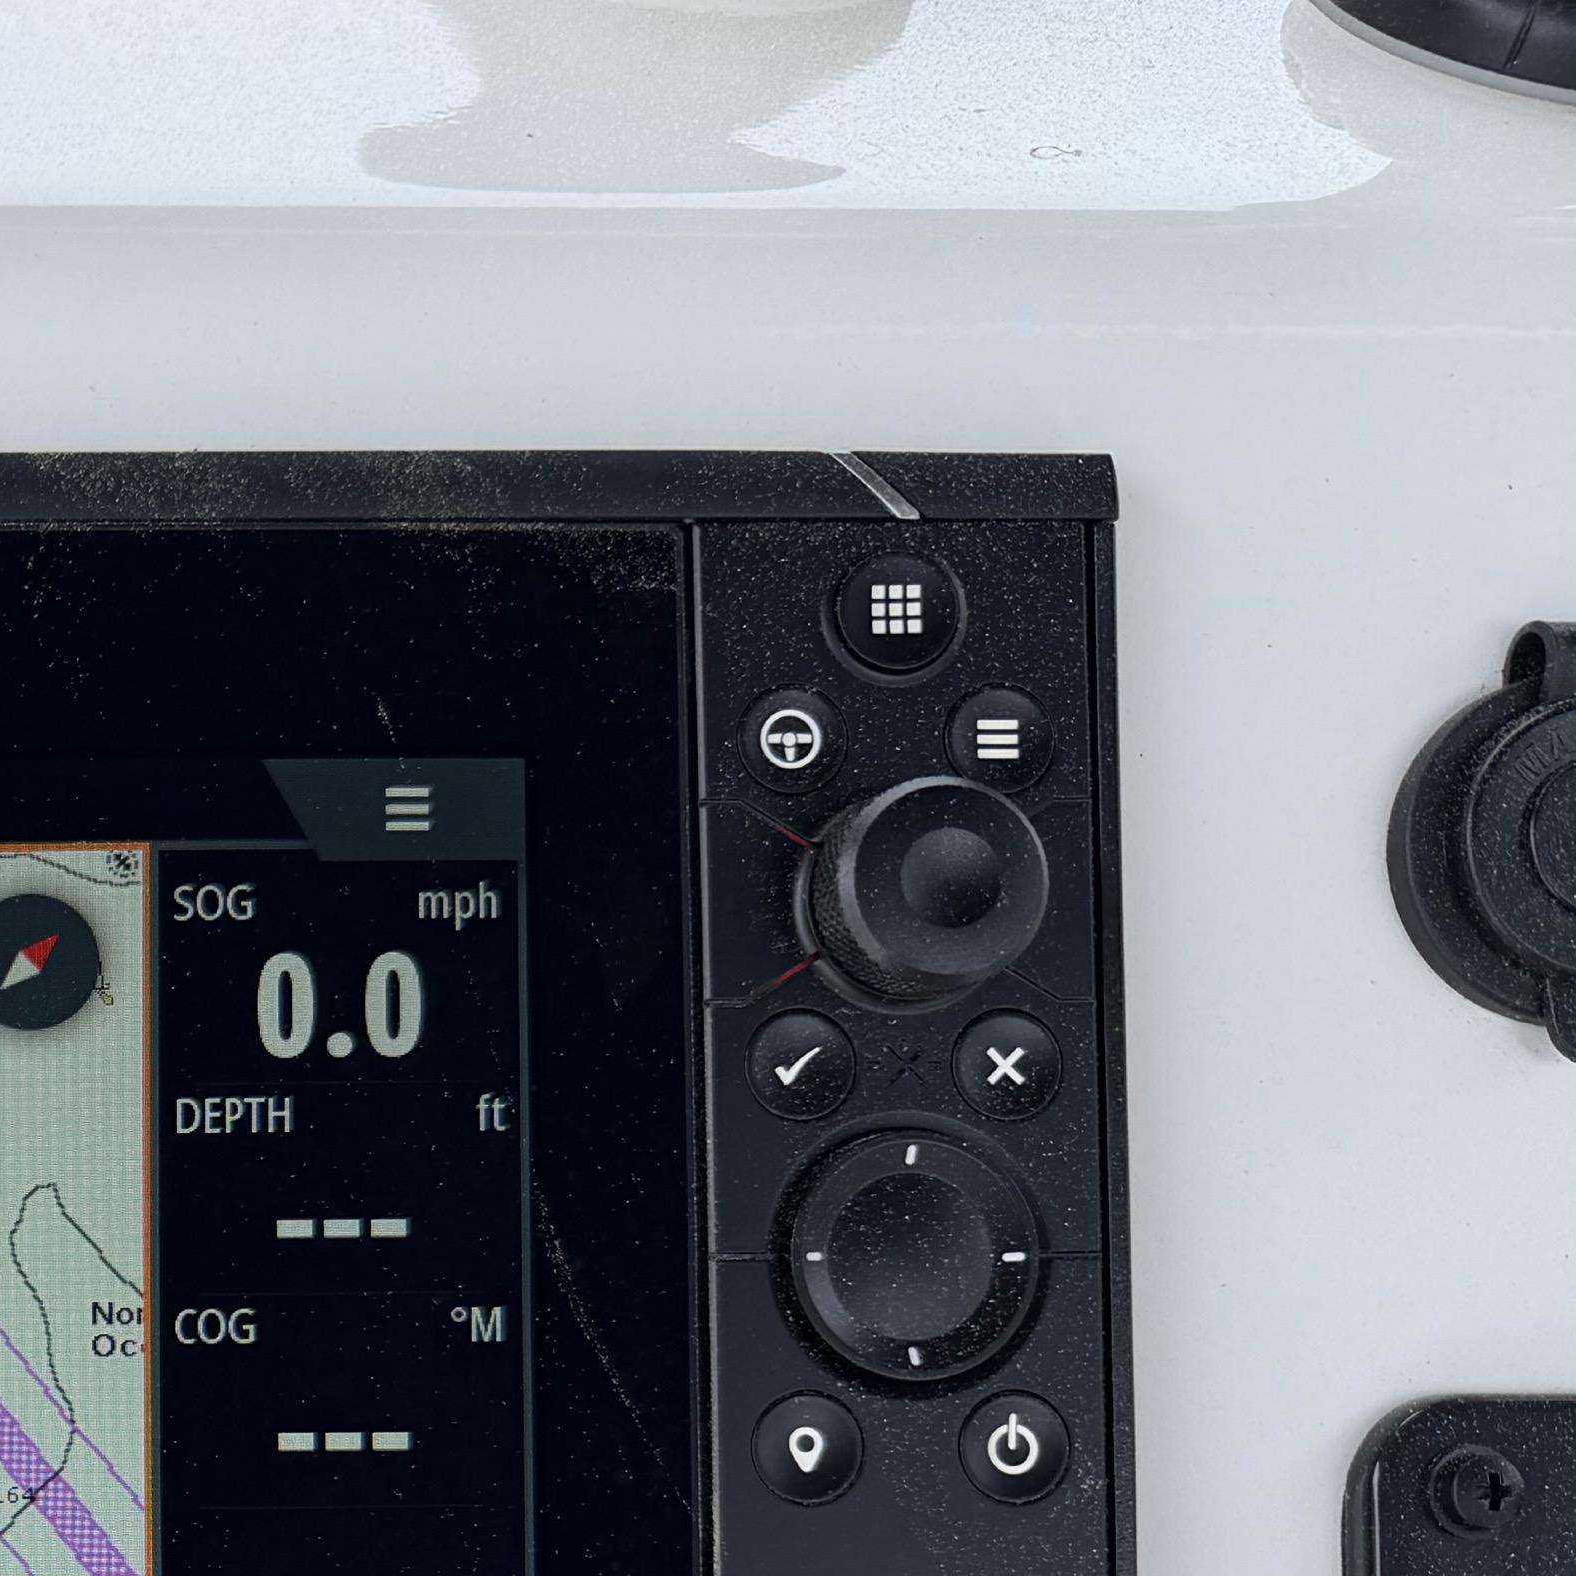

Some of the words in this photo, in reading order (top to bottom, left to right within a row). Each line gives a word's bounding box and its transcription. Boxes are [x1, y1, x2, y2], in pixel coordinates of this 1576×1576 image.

[173, 883, 255, 921] SOG
[417, 880, 500, 931] mph
[257, 951, 423, 1059] 0.0
[176, 1097, 294, 1134] DEPTH
[475, 1093, 511, 1132] ft
[174, 1307, 258, 1345] COG
[91, 1333, 145, 1358] Oc
